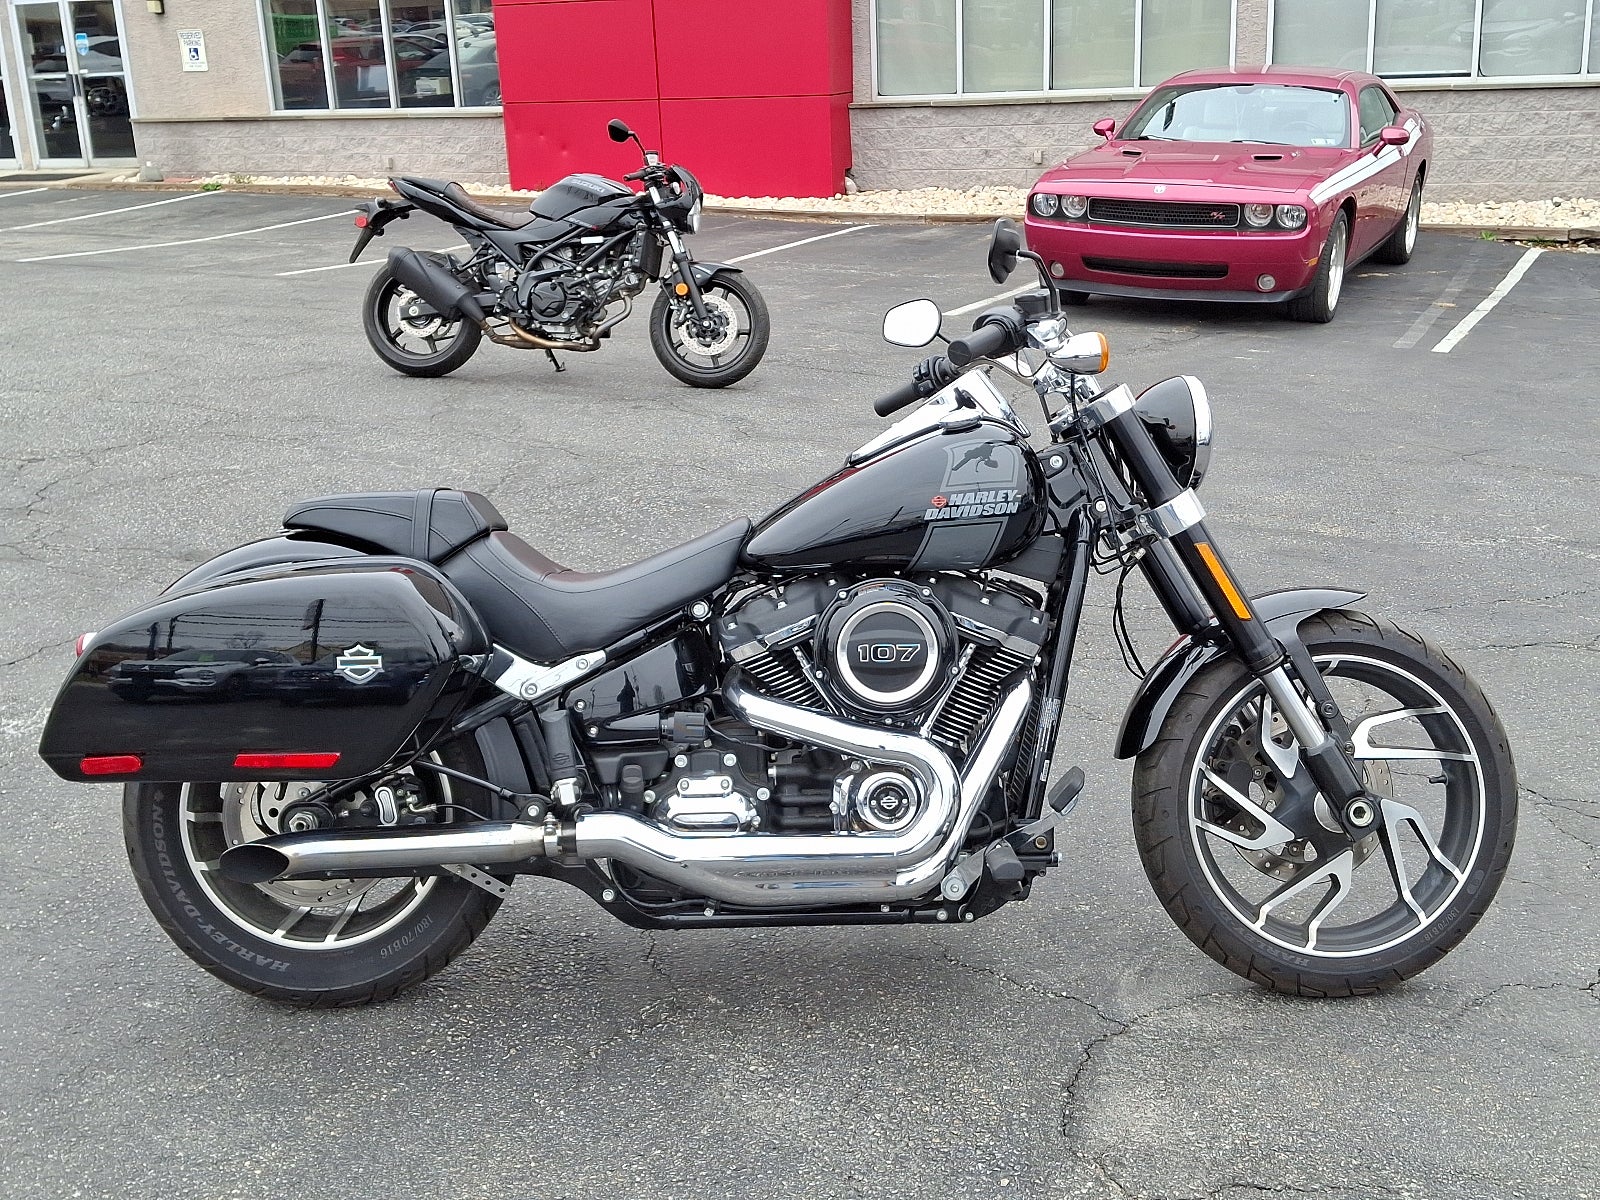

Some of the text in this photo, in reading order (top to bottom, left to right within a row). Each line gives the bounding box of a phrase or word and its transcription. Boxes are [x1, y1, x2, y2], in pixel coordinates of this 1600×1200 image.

[571, 178, 605, 193] SUZUKI
[948, 489, 1022, 506] HARLEY-
[923, 502, 1019, 521] DAVIDSON
[857, 643, 921, 663] 107
